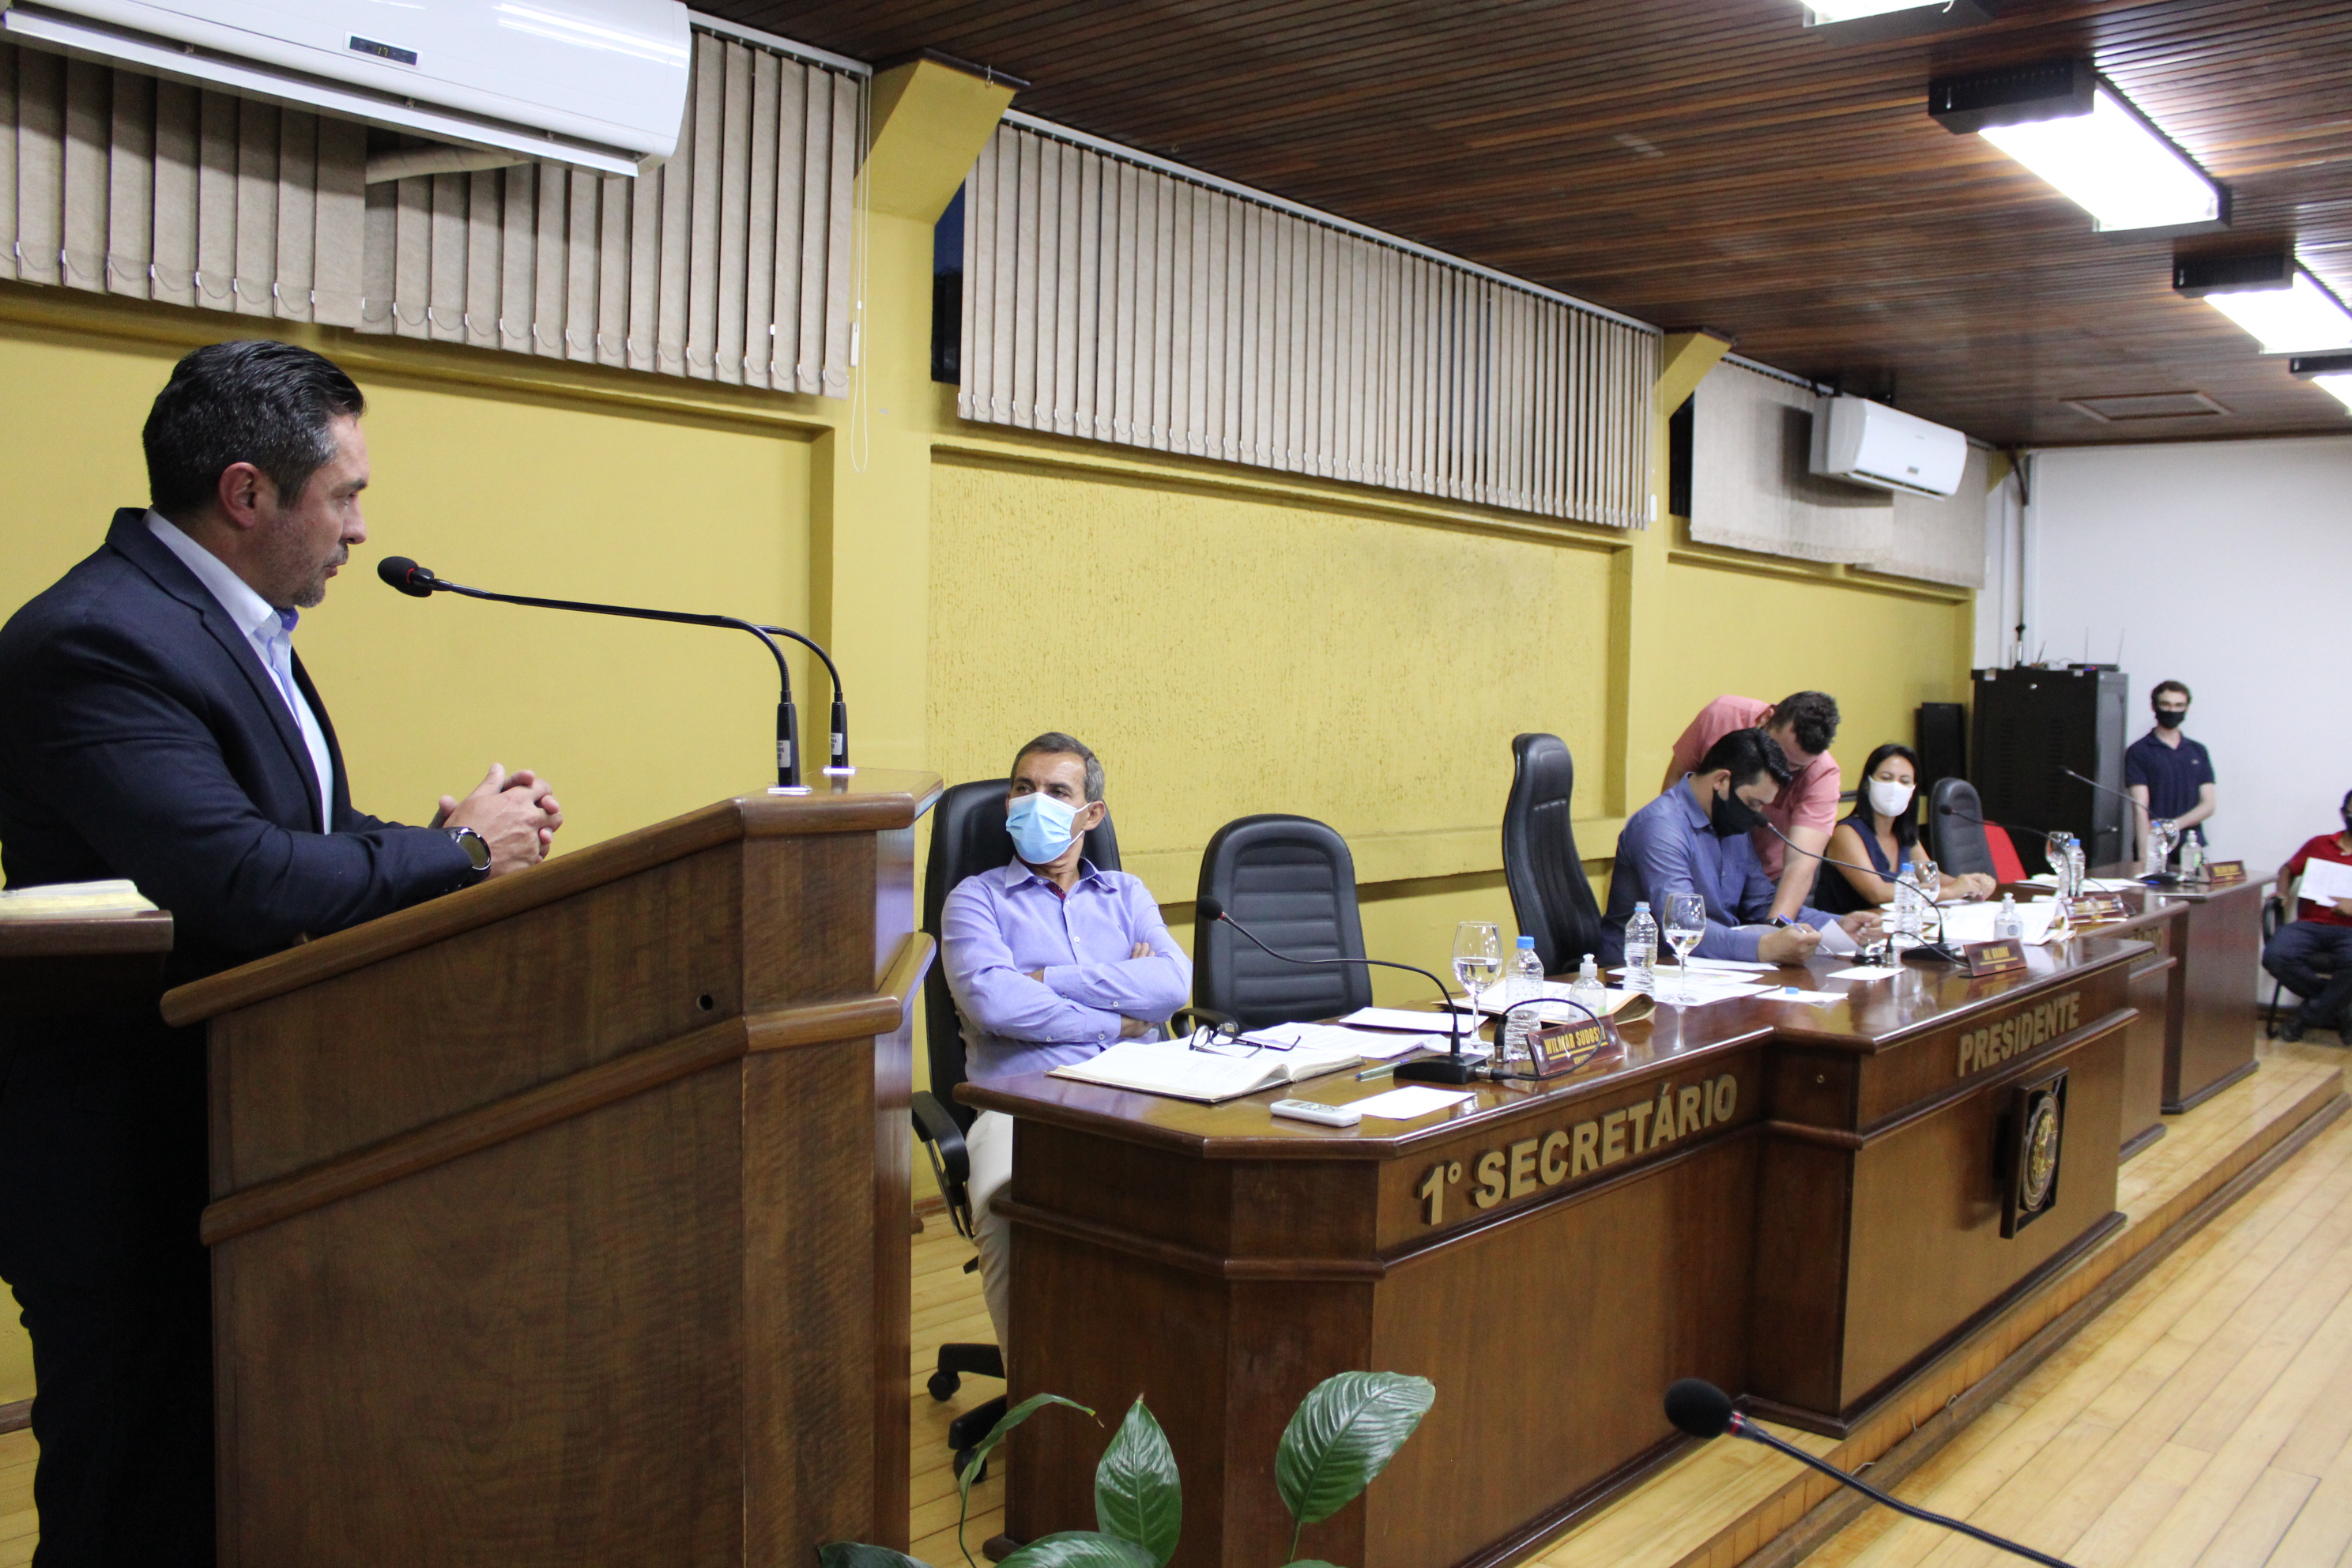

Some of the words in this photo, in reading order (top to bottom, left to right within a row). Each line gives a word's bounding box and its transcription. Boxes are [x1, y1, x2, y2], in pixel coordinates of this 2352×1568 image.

[1544, 1033, 1576, 1055] WILMAR
[1958, 991, 2081, 1078] PRESIDENTE
[1472, 1074, 1738, 1209] SECRETÁRIO
